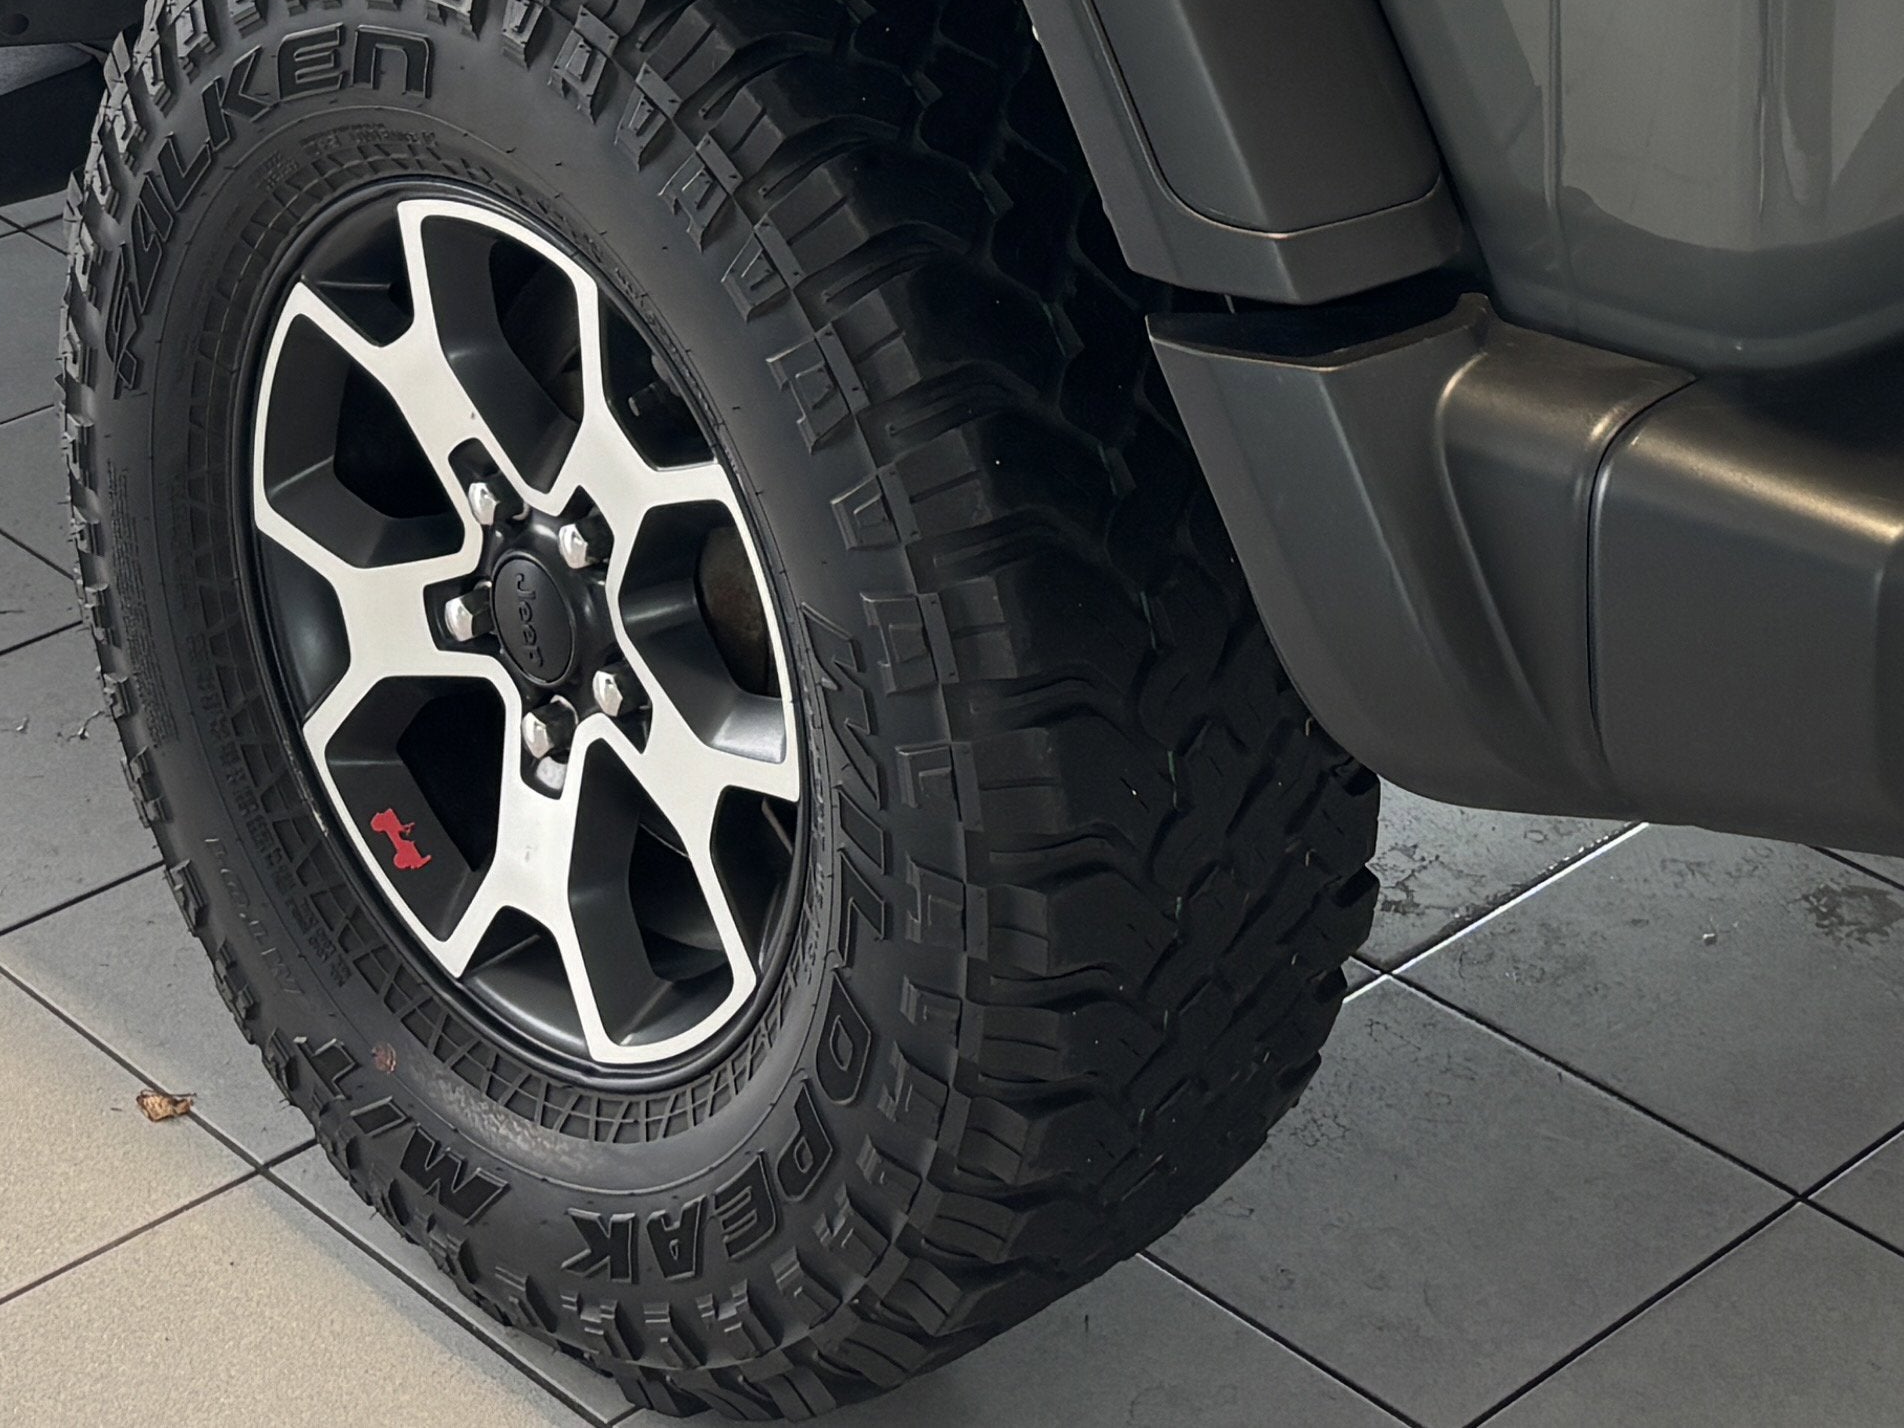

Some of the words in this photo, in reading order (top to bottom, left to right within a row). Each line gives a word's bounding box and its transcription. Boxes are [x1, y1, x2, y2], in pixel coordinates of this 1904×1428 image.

[104, 21, 432, 401] FALKEN
[515, 572, 545, 668] Jeep
[560, 601, 886, 1286] WILDPEAK
